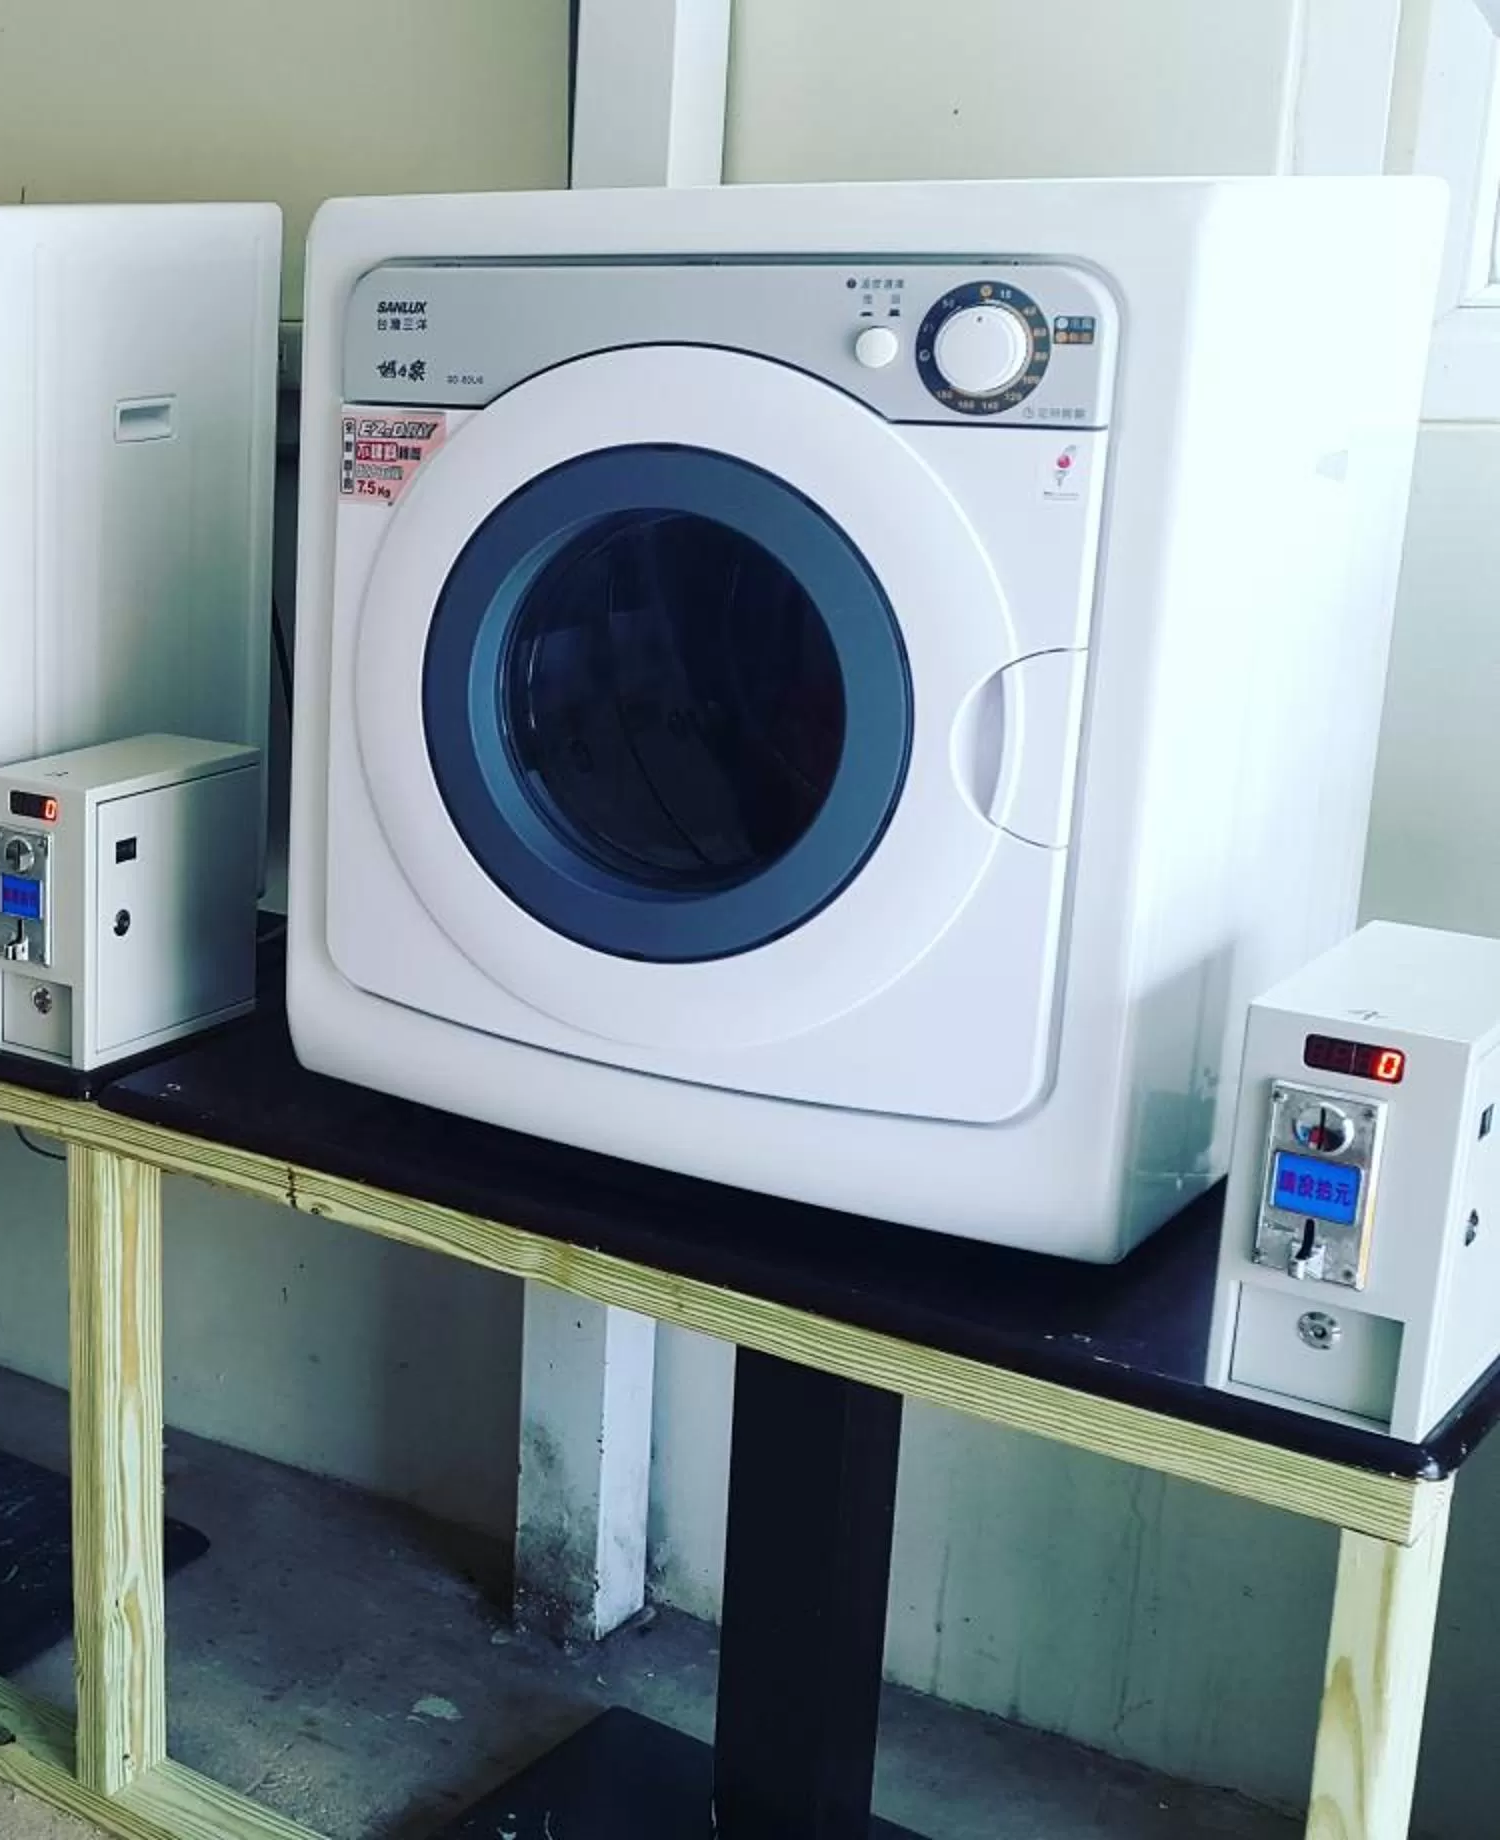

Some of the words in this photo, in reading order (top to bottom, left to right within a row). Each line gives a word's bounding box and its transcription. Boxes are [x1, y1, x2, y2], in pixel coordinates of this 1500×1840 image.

[376, 301, 427, 314] SANLUX
[377, 318, 427, 331] 台灣三洋
[357, 480, 377, 495] 7.5
[45, 799, 57, 819] 0
[1377, 1051, 1402, 1079] 0
